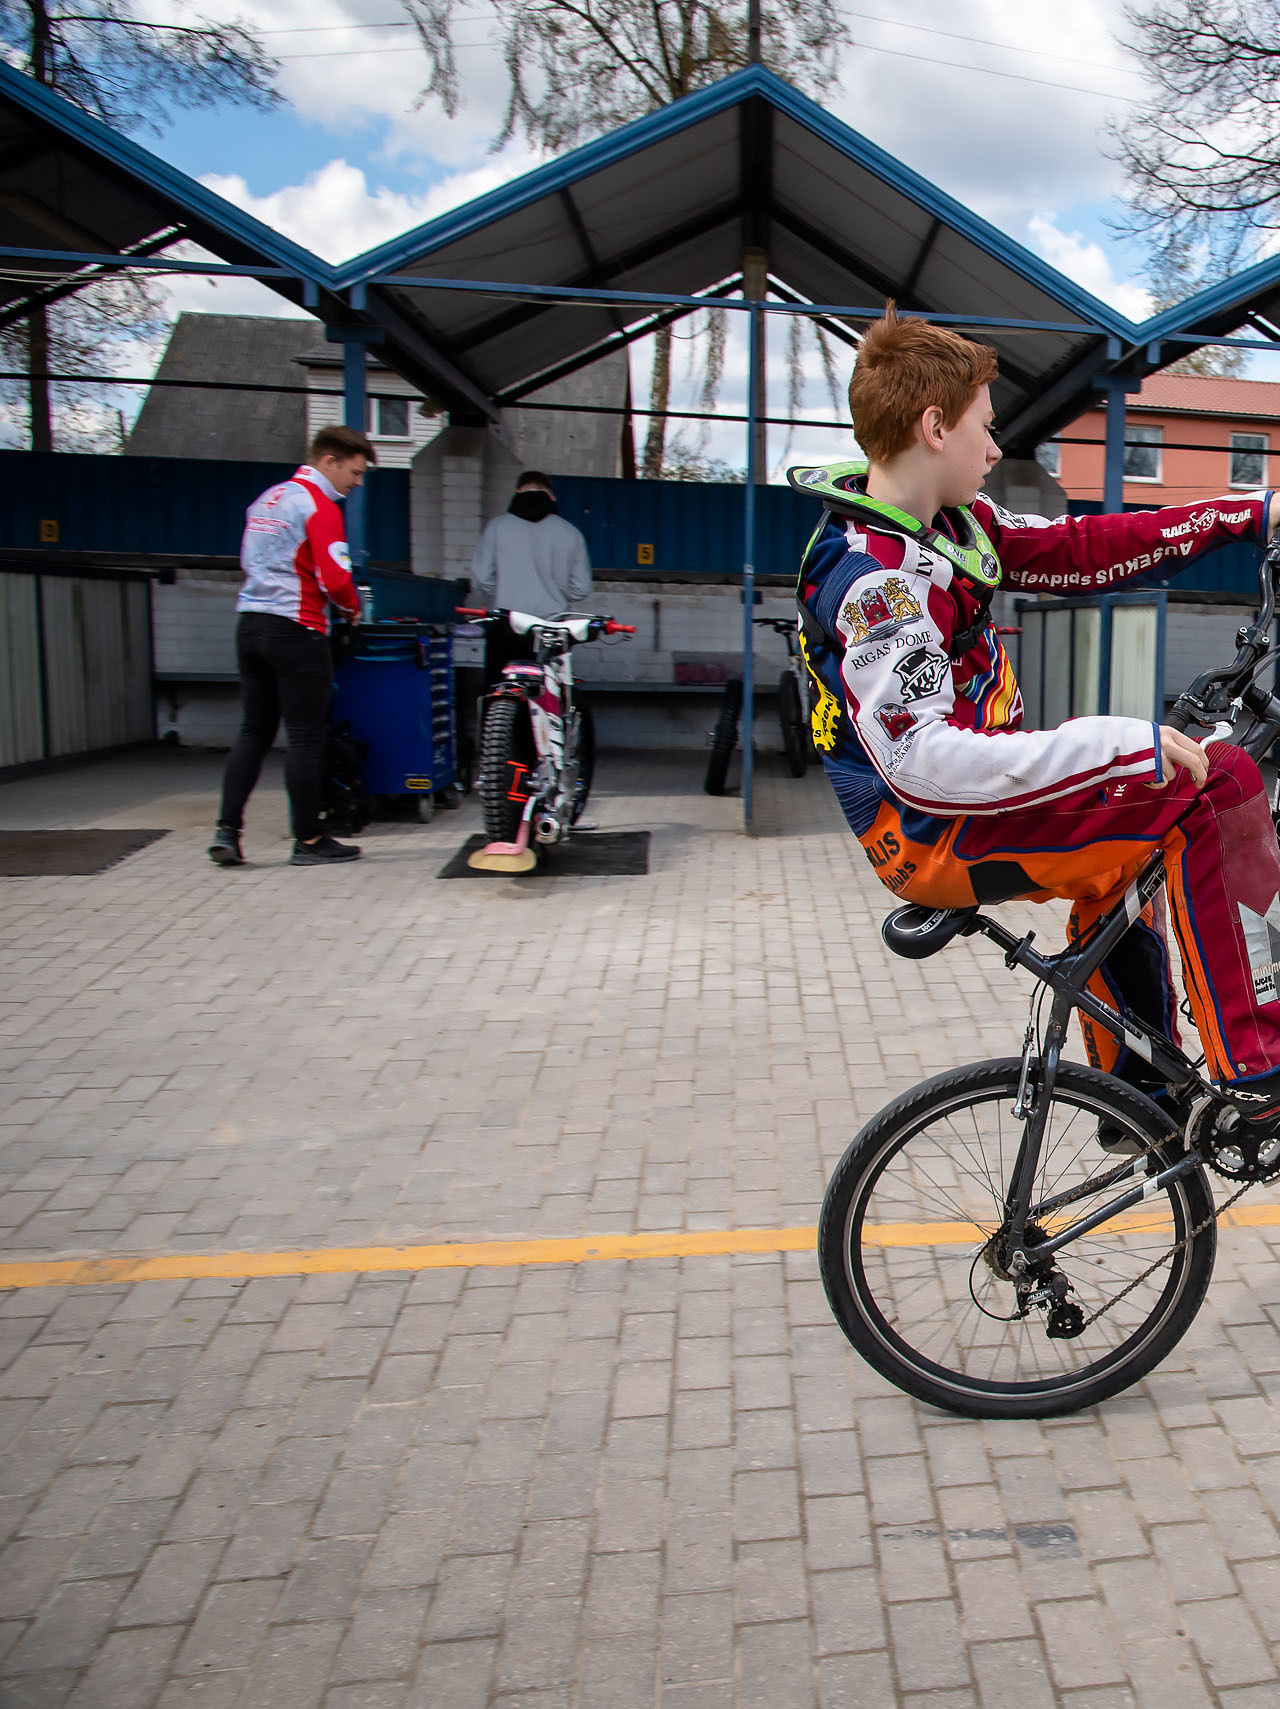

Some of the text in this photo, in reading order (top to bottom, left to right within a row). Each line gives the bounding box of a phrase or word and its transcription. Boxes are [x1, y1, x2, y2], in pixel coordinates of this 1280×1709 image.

[1160, 508, 1252, 539] RACE WEAR
[895, 630, 934, 649] DOME
[1225, 1088, 1271, 1102] TCX
